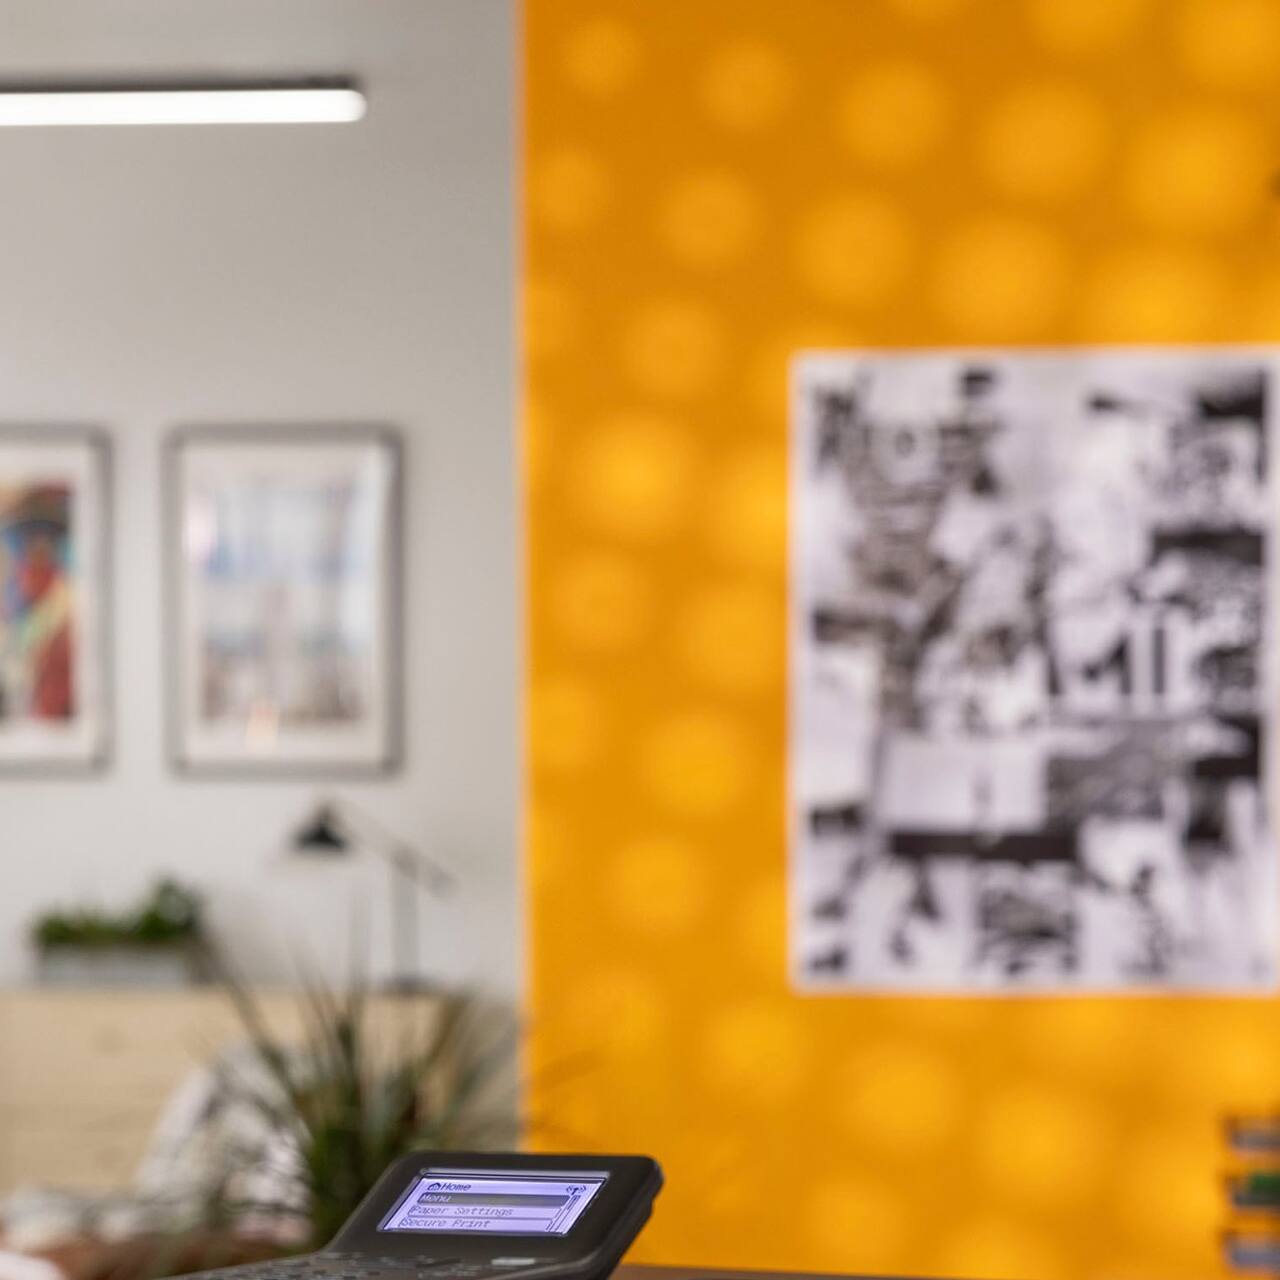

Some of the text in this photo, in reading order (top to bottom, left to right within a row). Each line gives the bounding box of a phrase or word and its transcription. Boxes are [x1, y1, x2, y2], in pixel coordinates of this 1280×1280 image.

[440, 1182, 472, 1192] Home
[421, 1194, 452, 1203] Menu
[409, 1206, 513, 1217] Paper Settings
[399, 1218, 492, 1229] Secure Print
